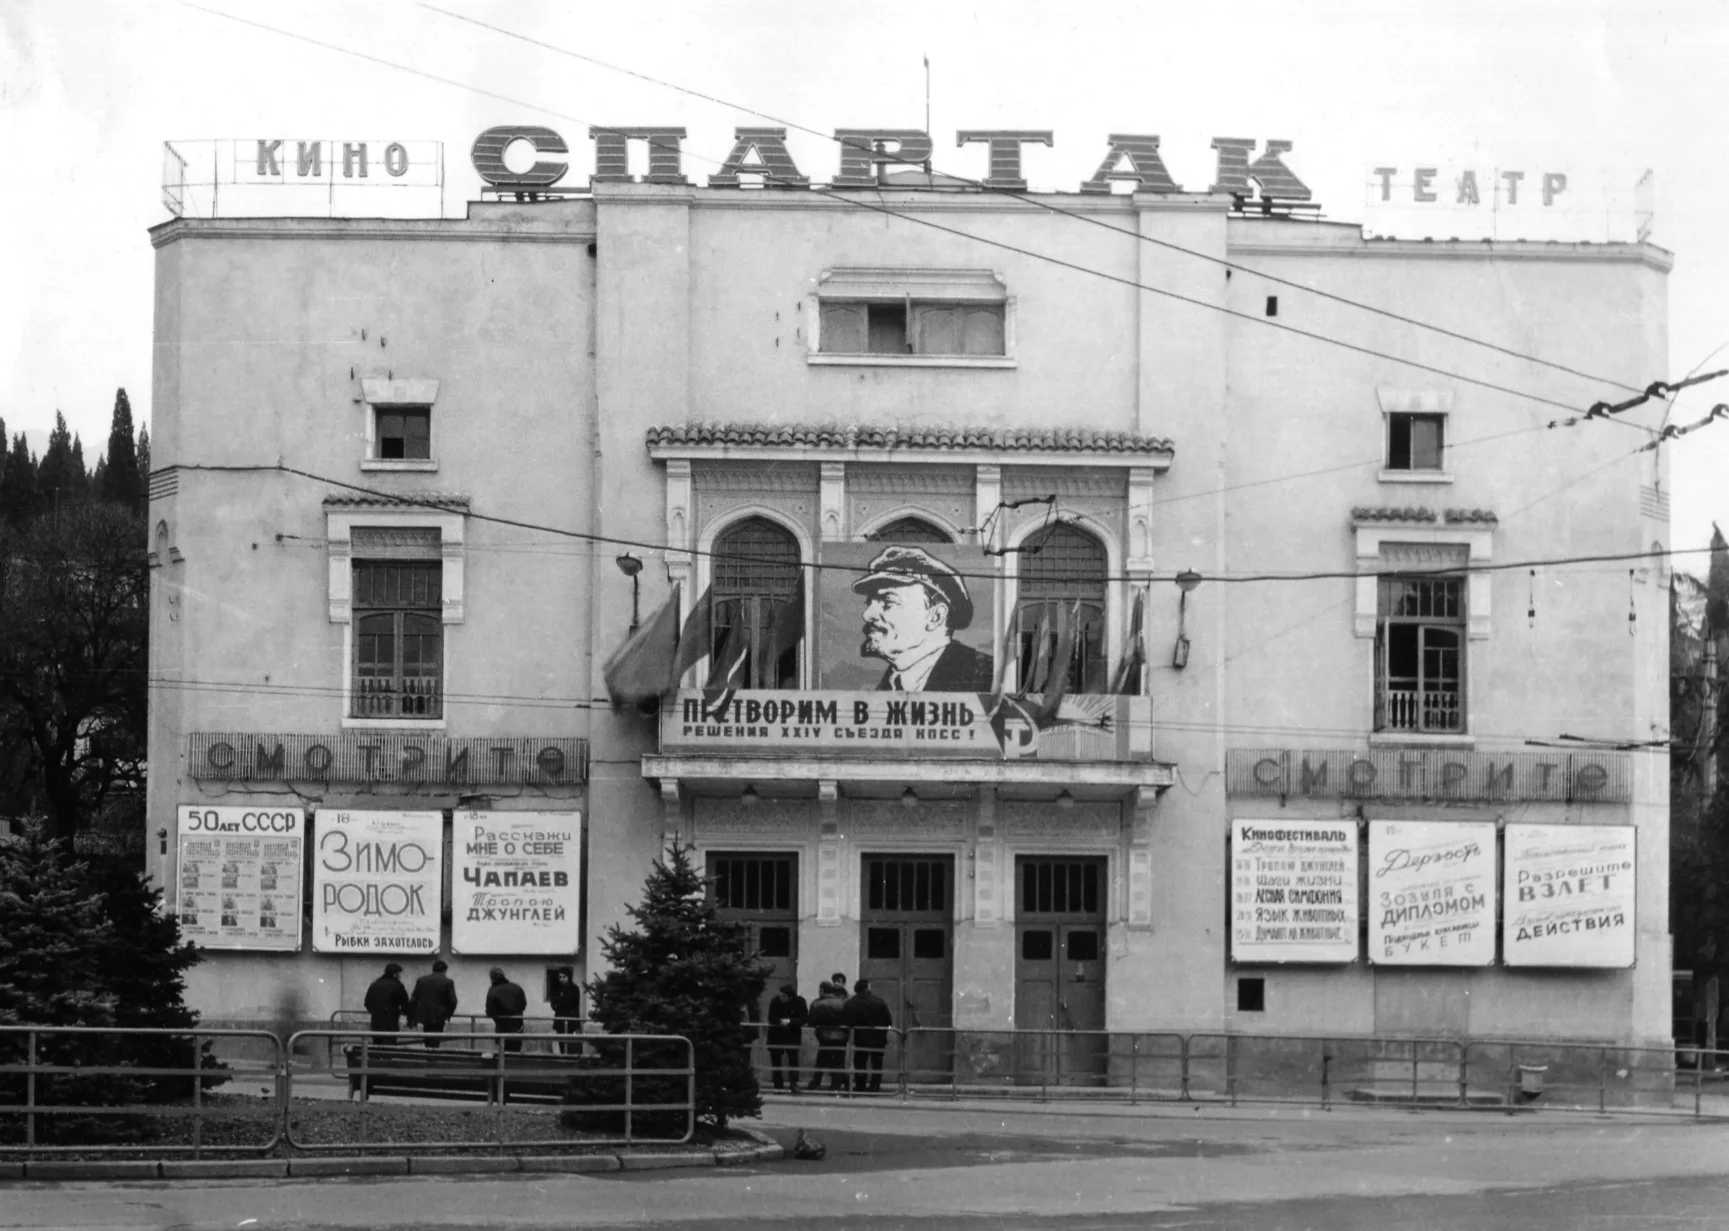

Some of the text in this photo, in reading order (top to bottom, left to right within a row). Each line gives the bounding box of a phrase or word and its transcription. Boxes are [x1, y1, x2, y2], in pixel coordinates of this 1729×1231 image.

[256, 139, 410, 177] КИНО
[471, 125, 1312, 199] СПАРТАК
[1372, 167, 1568, 206] ТЕАТР
[853, 700, 869, 725] В
[886, 700, 974, 726] ЖИЗНЬ
[683, 726, 768, 738] РЕШЕНИЯ
[834, 727, 903, 739] СЪЕЗДА
[188, 810, 219, 831] 50
[242, 812, 296, 832] СССР
[466, 842, 564, 855] МНЕ О СЕБЕ
[463, 867, 569, 887] ЧАПАЕВ
[1519, 873, 1617, 902] ВЗЛЕТ
[323, 883, 425, 917] РОДОК
[466, 904, 565, 922] ДЖУНГЛЕЙ
[1381, 894, 1485, 929] ДИПЛОМОМ
[1516, 912, 1625, 943] ДЕЙСТВИЯ
